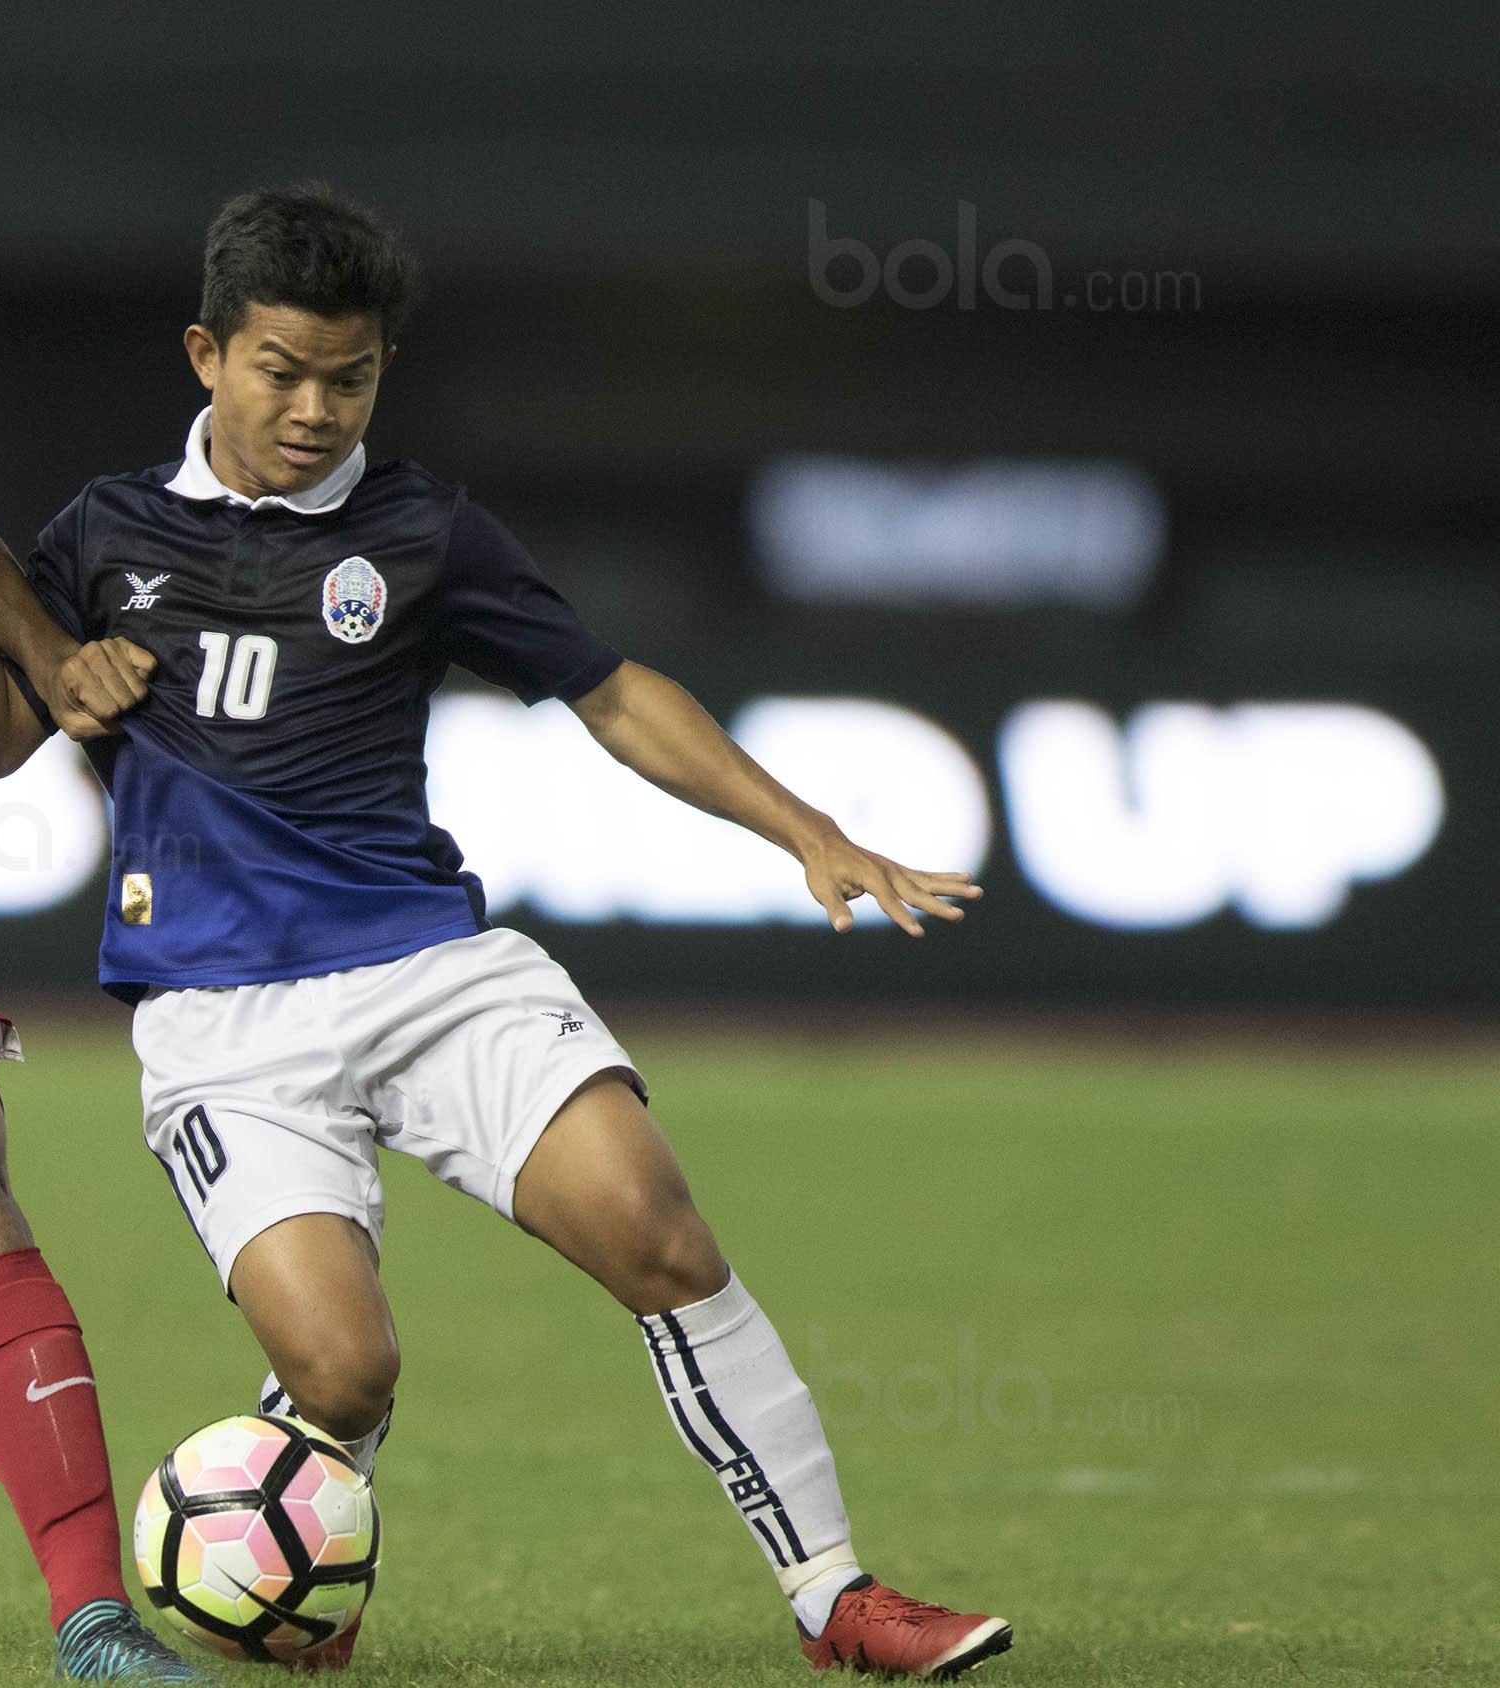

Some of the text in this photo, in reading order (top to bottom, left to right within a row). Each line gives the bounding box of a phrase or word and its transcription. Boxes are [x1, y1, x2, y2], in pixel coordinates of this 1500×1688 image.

[120, 595, 161, 610] FBT
[340, 602, 370, 616] FFC
[195, 631, 279, 720] 10
[557, 1021, 585, 1037] FBT
[172, 1103, 231, 1208] 10
[716, 1452, 783, 1514] FBT
